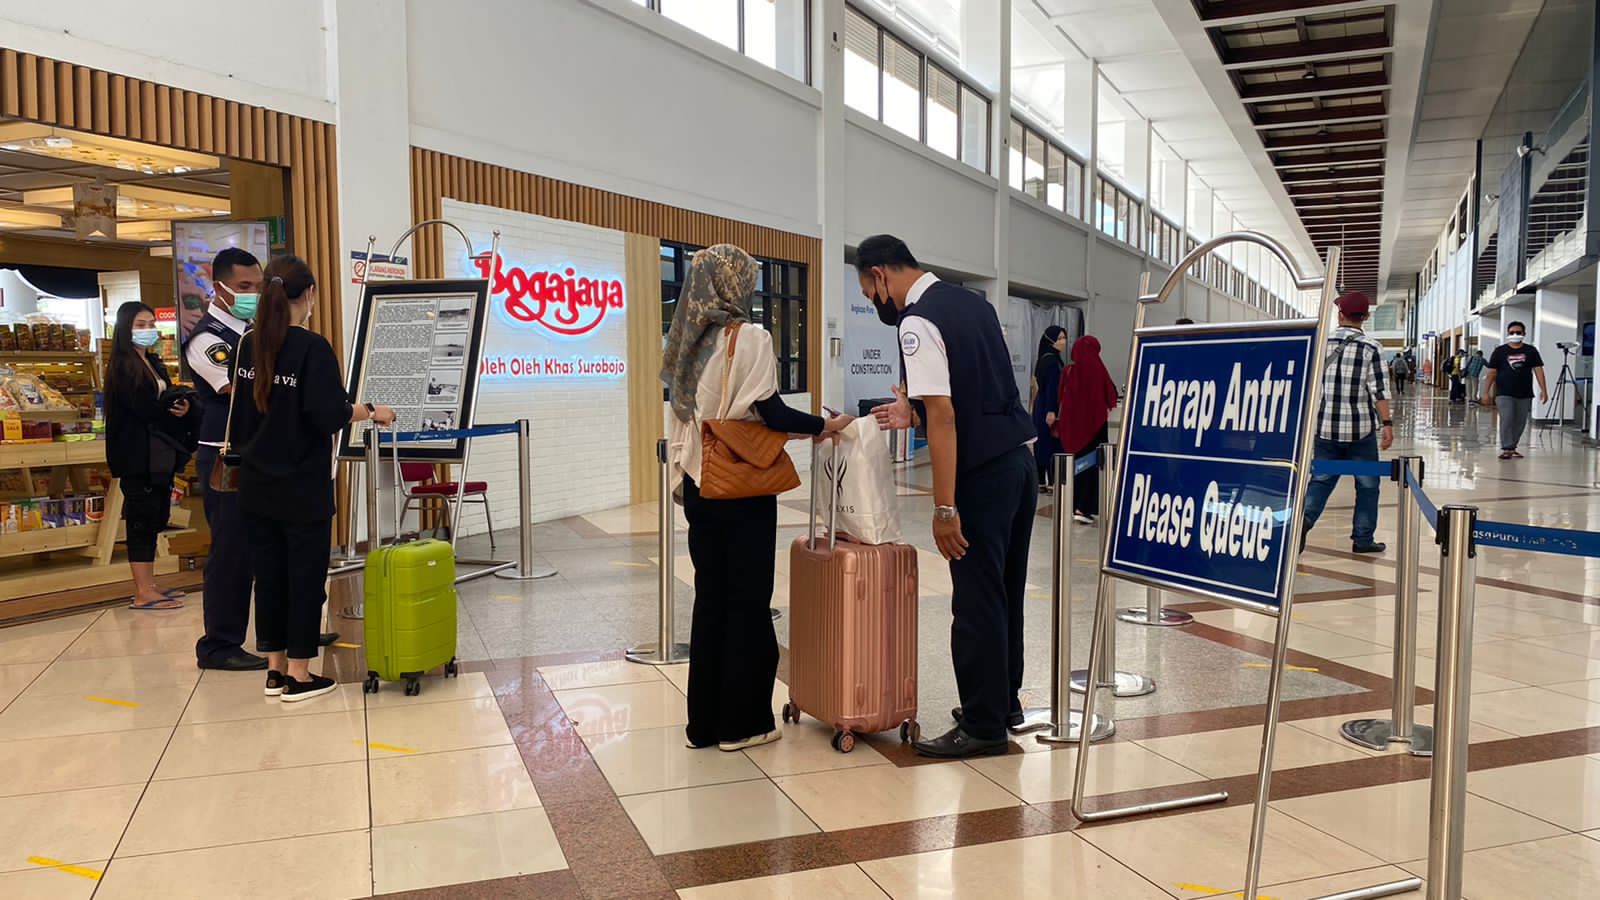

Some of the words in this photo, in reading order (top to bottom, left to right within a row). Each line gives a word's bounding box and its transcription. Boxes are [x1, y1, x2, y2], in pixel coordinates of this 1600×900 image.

[474, 251, 624, 336] Bogajaya
[159, 311, 176, 320] COOK
[862, 348, 881, 360] UNDER
[510, 358, 541, 376] Oleh
[544, 358, 574, 375] Khas
[578, 358, 625, 375] Surobojo
[850, 363, 893, 375] CONSTRUCTION
[1141, 363, 1217, 448] Harap
[1219, 360, 1295, 433] Antri
[1127, 473, 1195, 548] Please
[1200, 480, 1273, 561] Queue
